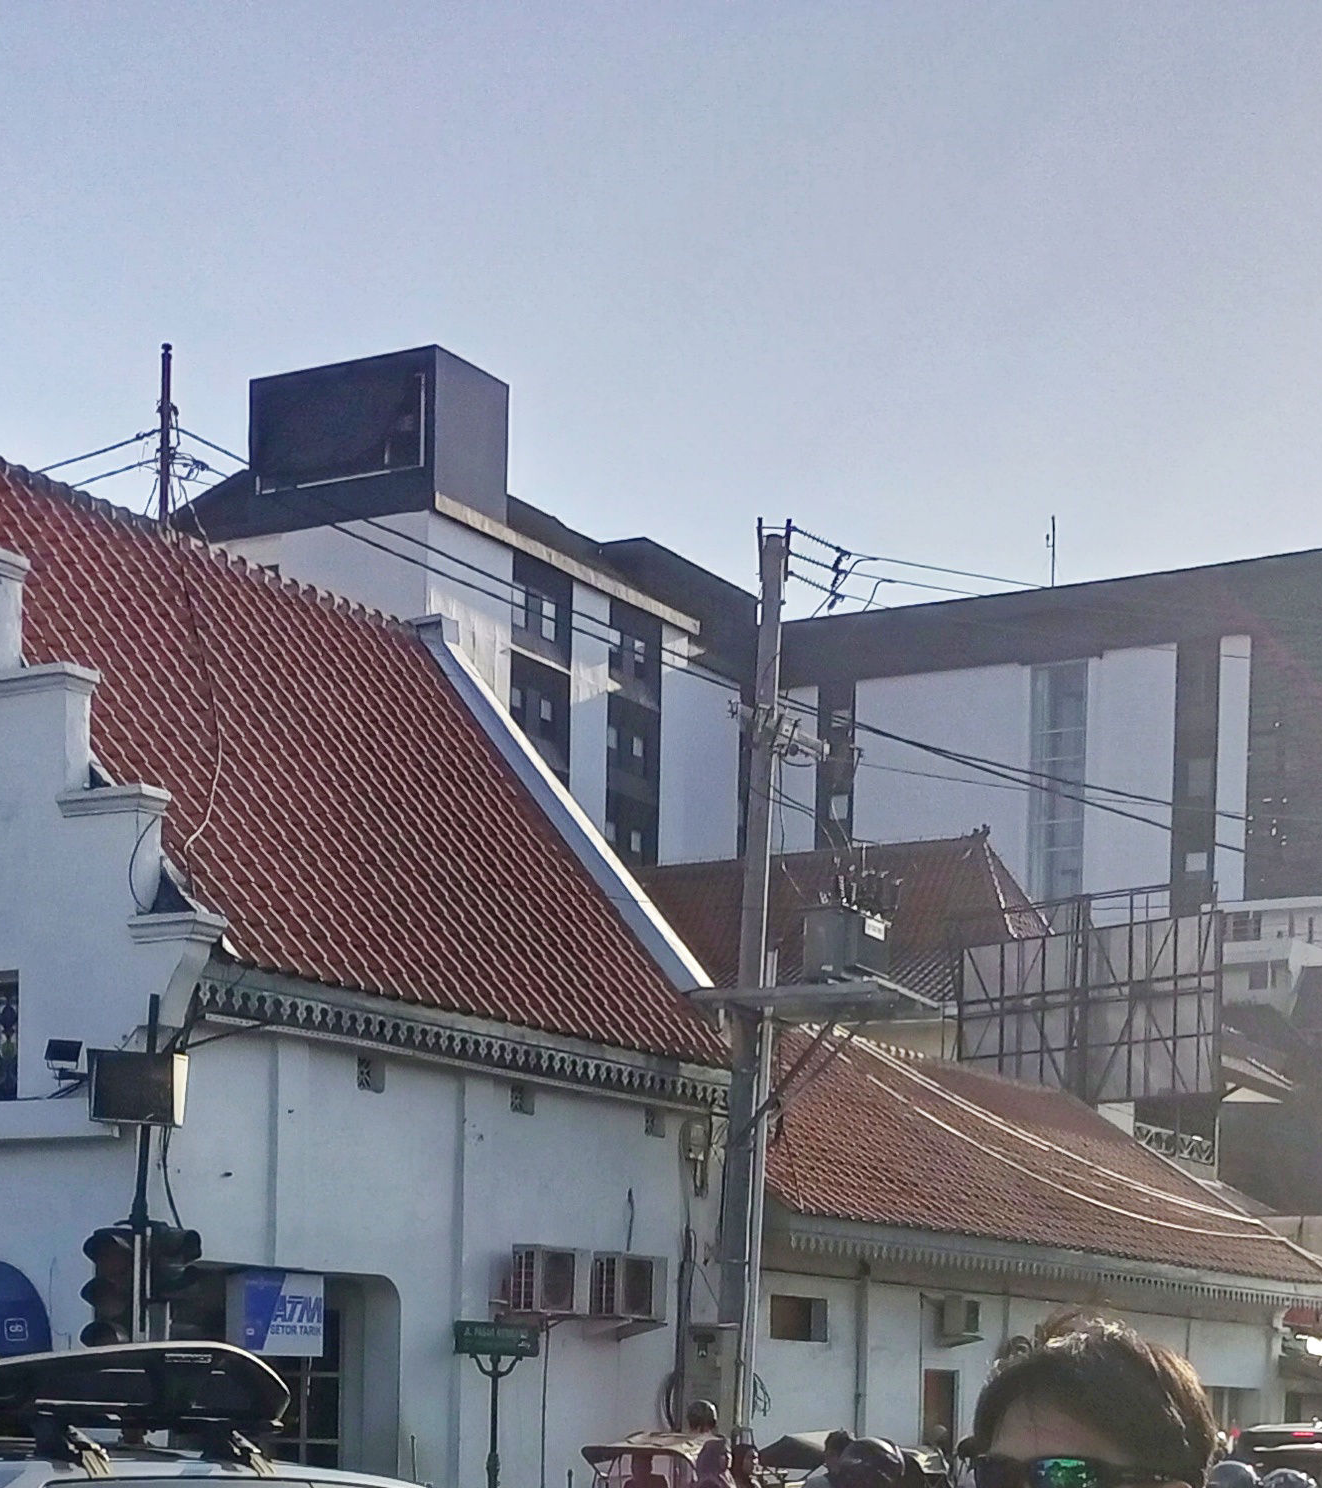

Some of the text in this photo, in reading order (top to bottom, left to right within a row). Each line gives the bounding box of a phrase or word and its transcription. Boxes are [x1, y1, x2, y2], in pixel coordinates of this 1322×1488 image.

[273, 1295, 323, 1323] ATM
[269, 1324, 322, 1336] SETOR TARIK
